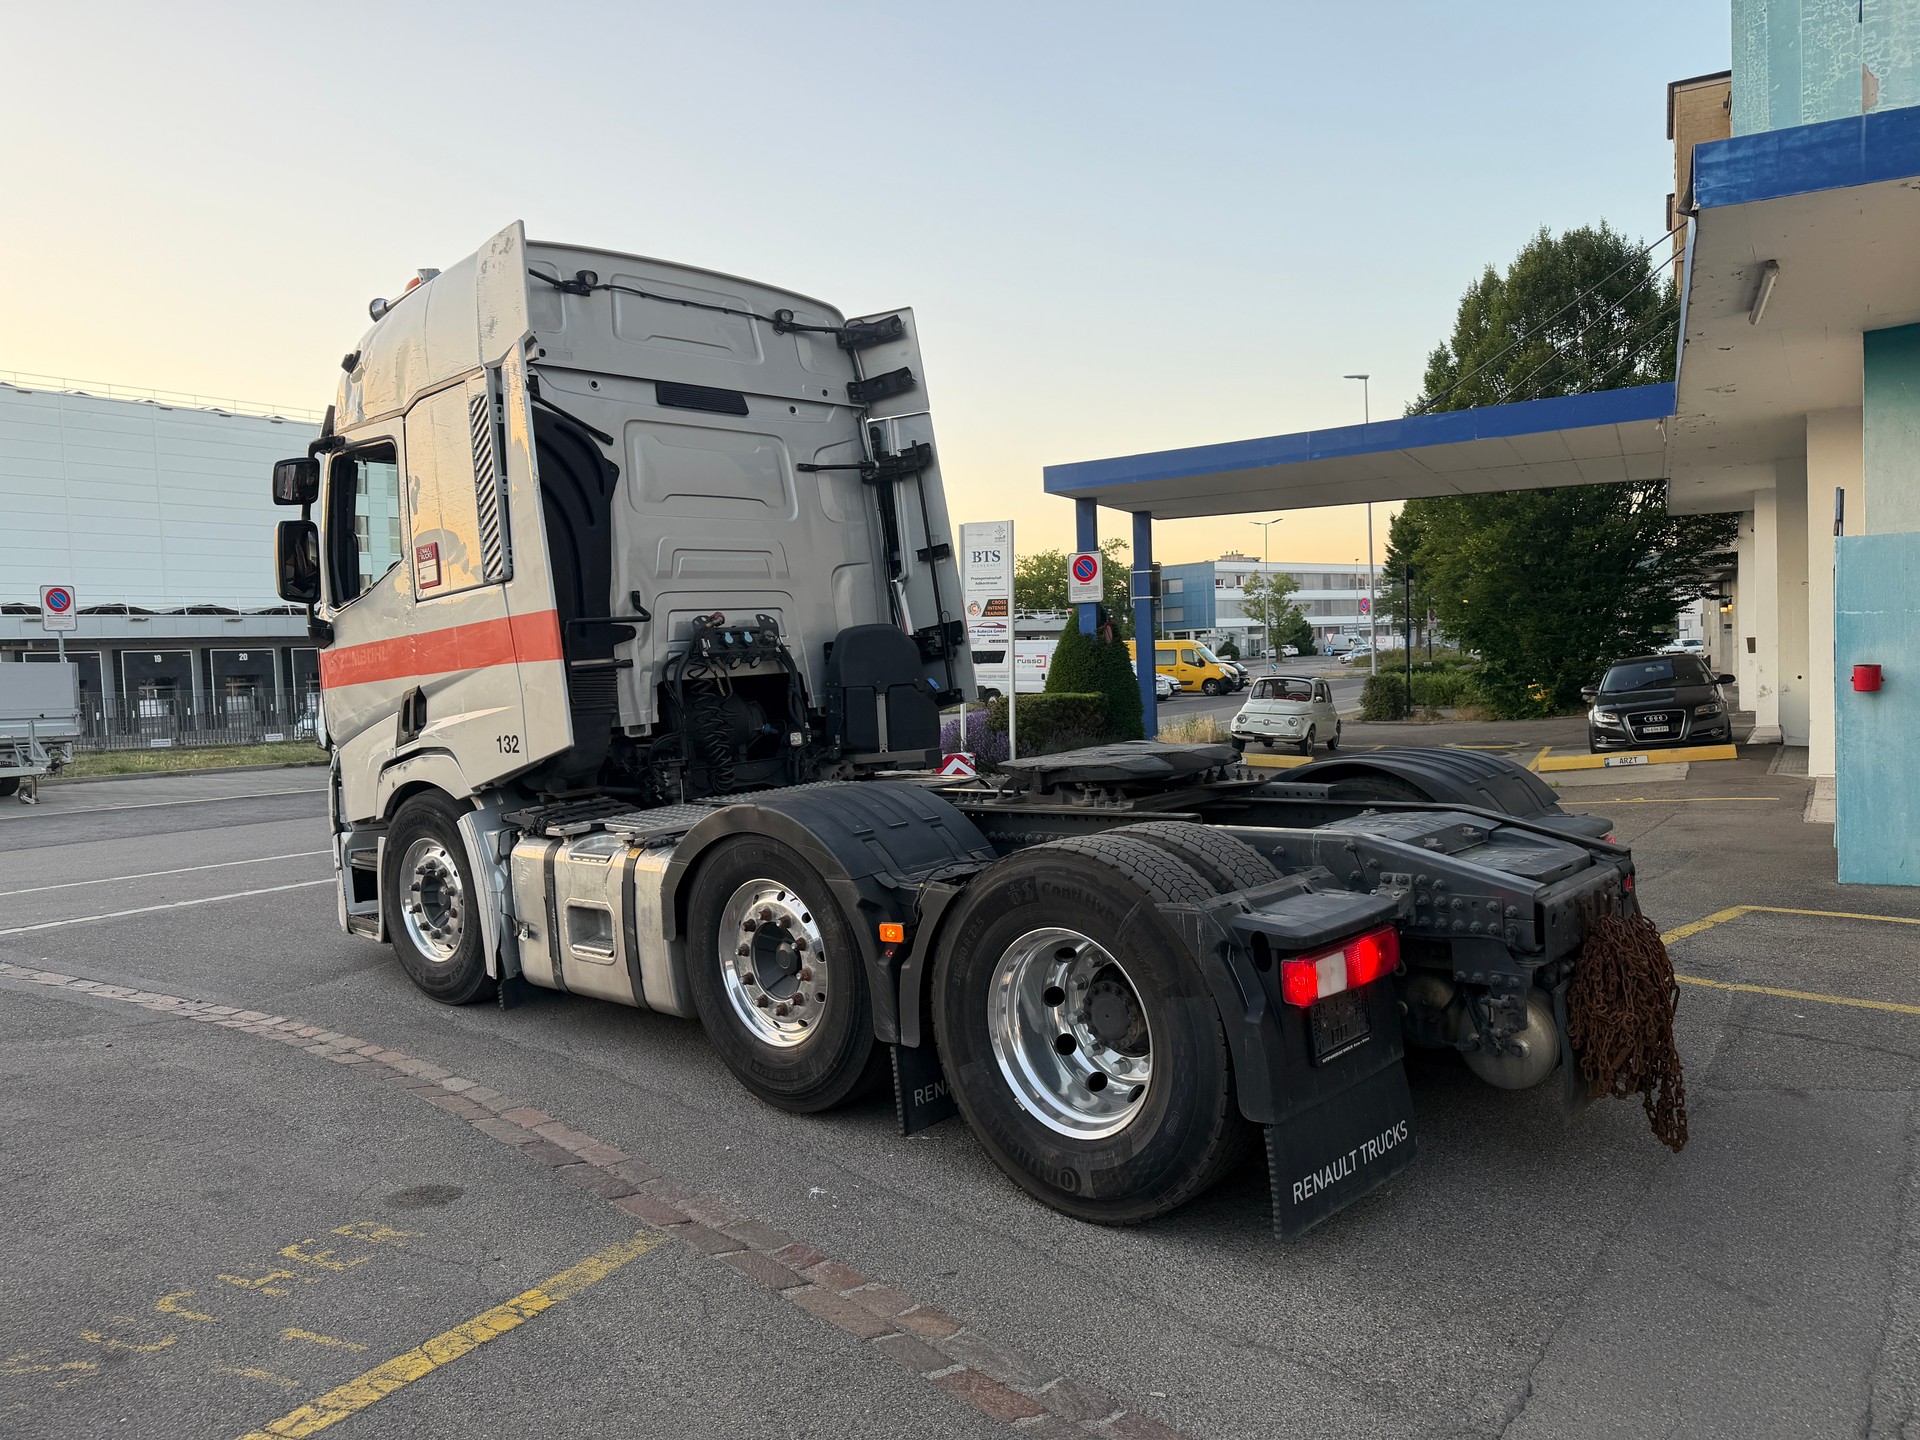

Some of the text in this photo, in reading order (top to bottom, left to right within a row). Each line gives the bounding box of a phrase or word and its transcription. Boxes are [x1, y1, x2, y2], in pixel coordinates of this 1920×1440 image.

[972, 550, 1001, 563] BTS
[153, 654, 163, 663] 19
[238, 652, 249, 662] 20
[496, 734, 520, 754] 132
[1619, 756, 1638, 764] ARZT
[1292, 1119, 1408, 1205] RENAULT TRUCKS
